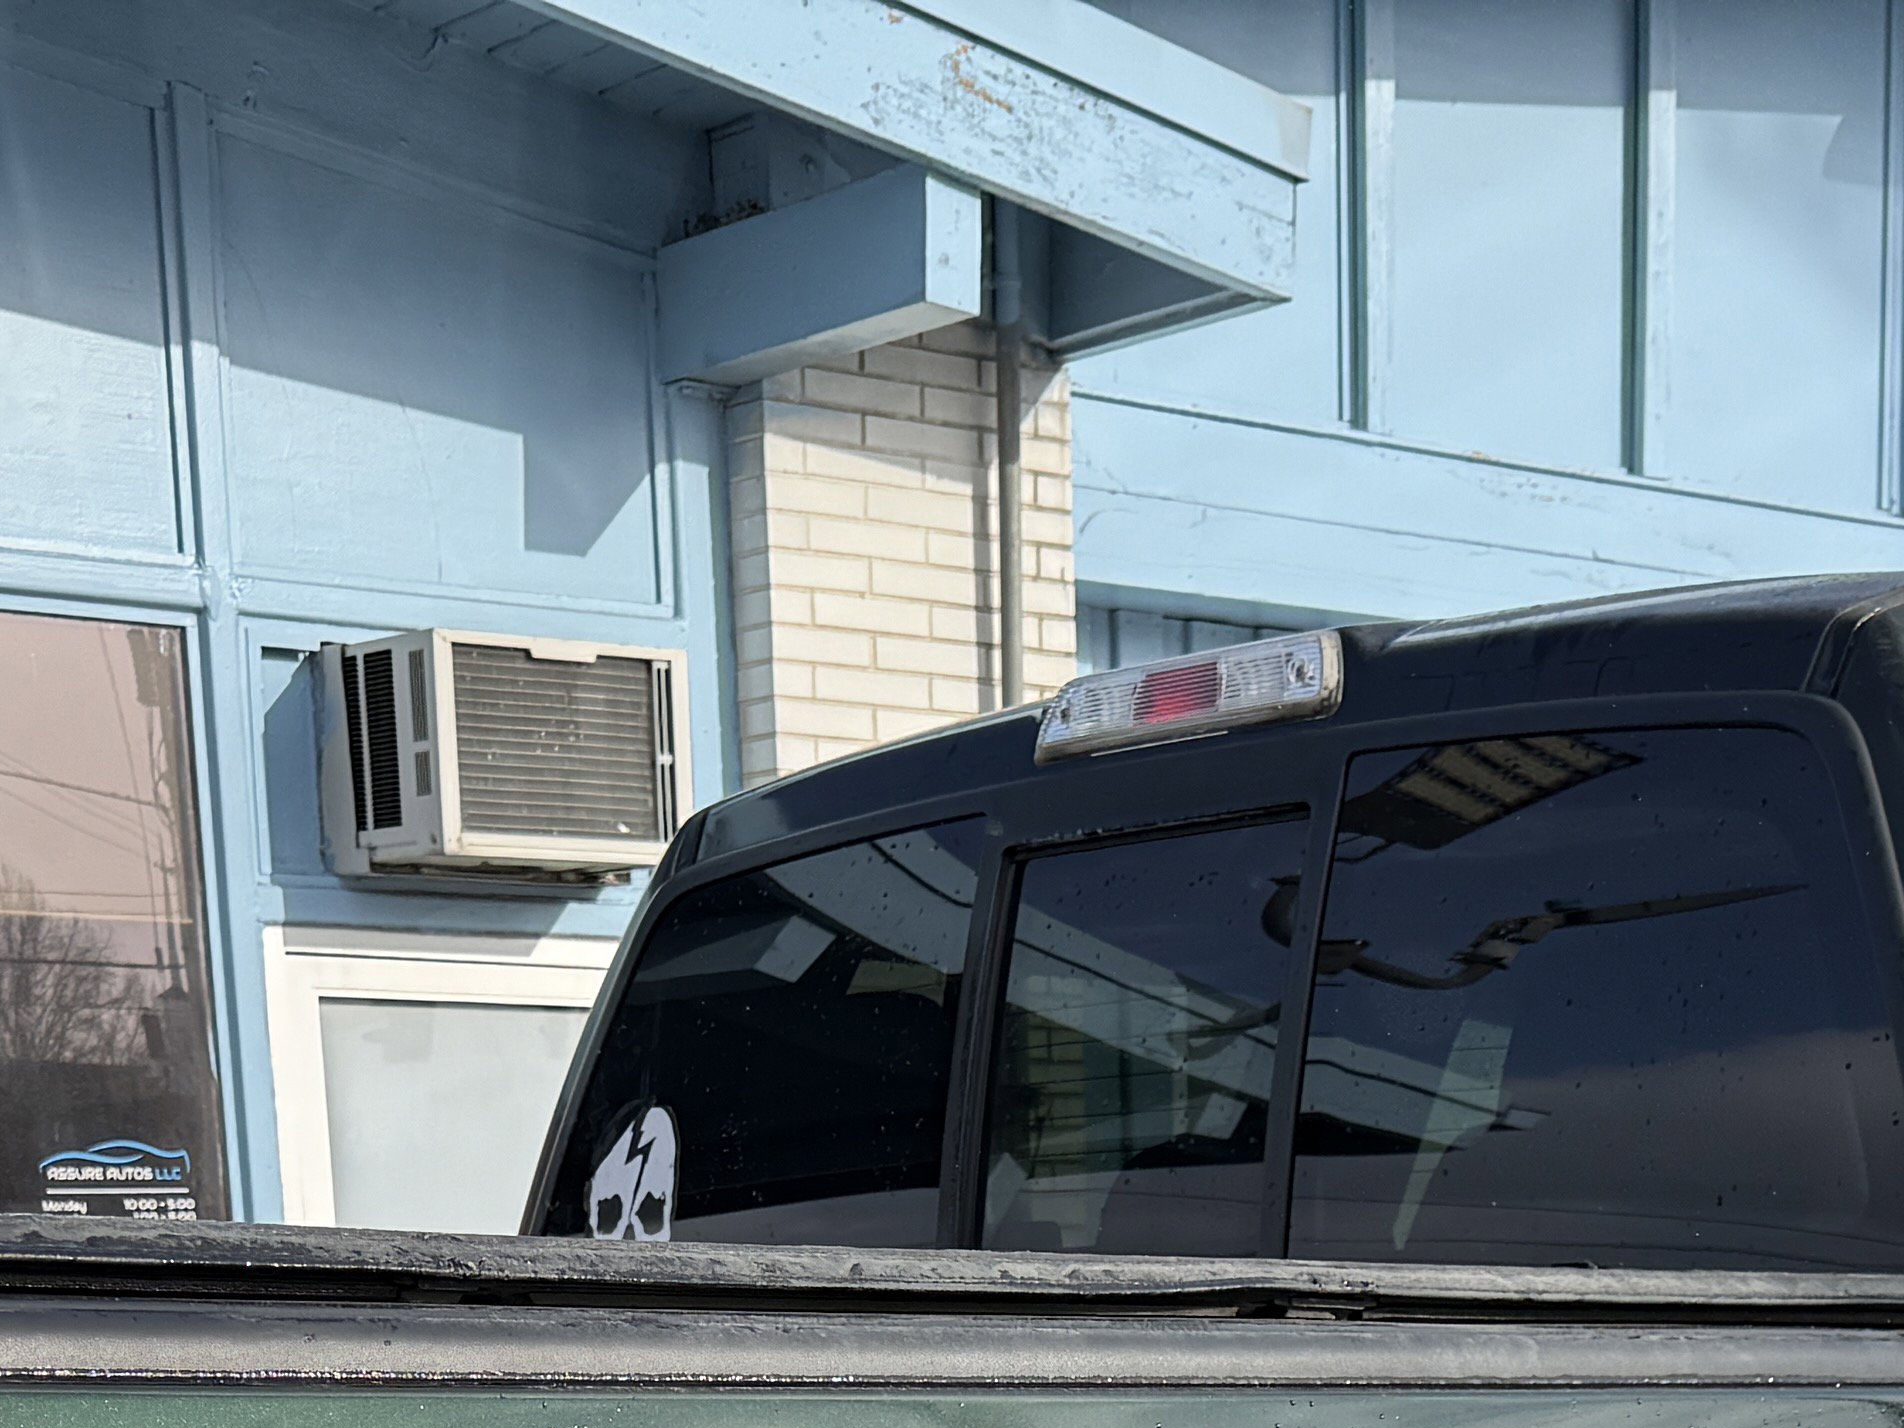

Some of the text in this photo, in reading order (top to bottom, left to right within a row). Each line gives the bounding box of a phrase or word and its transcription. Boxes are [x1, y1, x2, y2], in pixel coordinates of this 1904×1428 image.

[46, 1165, 182, 1181] ASSURE AUTOS LLC
